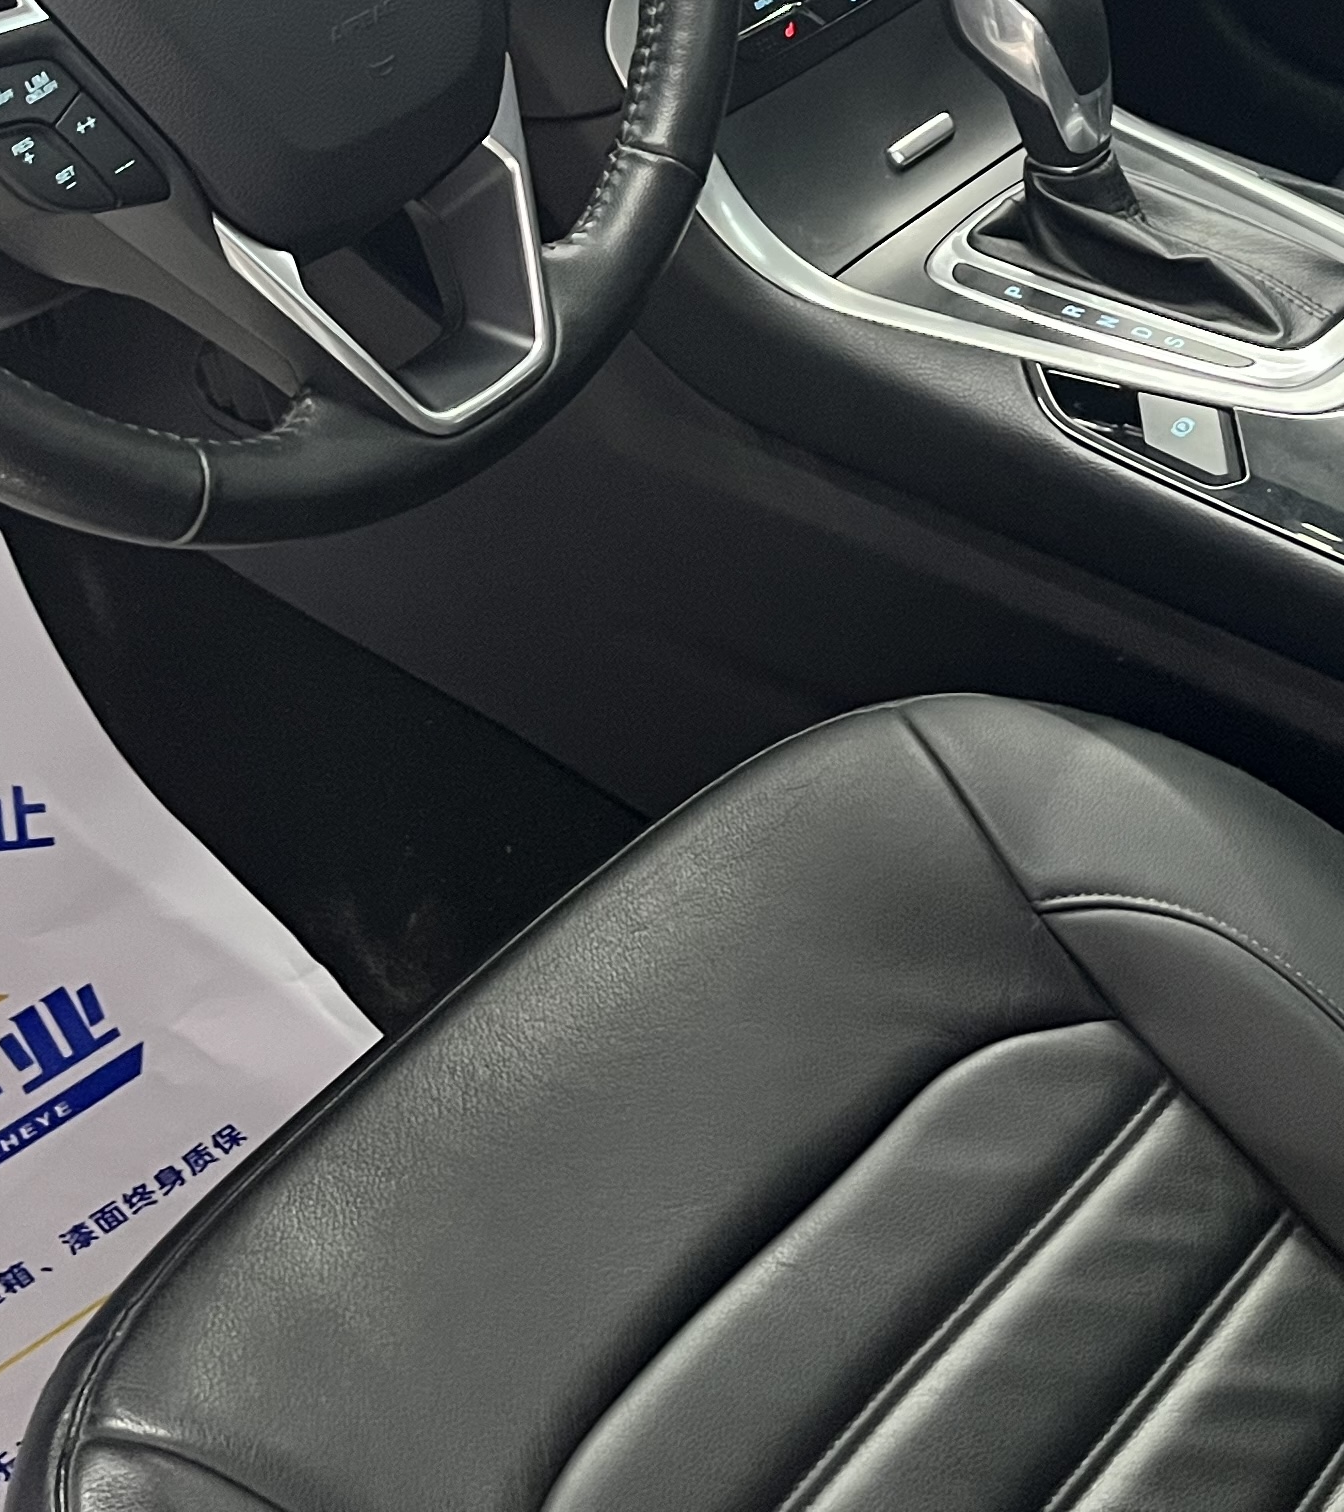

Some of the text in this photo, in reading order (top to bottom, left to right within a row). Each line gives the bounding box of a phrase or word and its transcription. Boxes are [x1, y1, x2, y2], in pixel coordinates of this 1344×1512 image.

[1003, 285, 1185, 349] P R N D S
